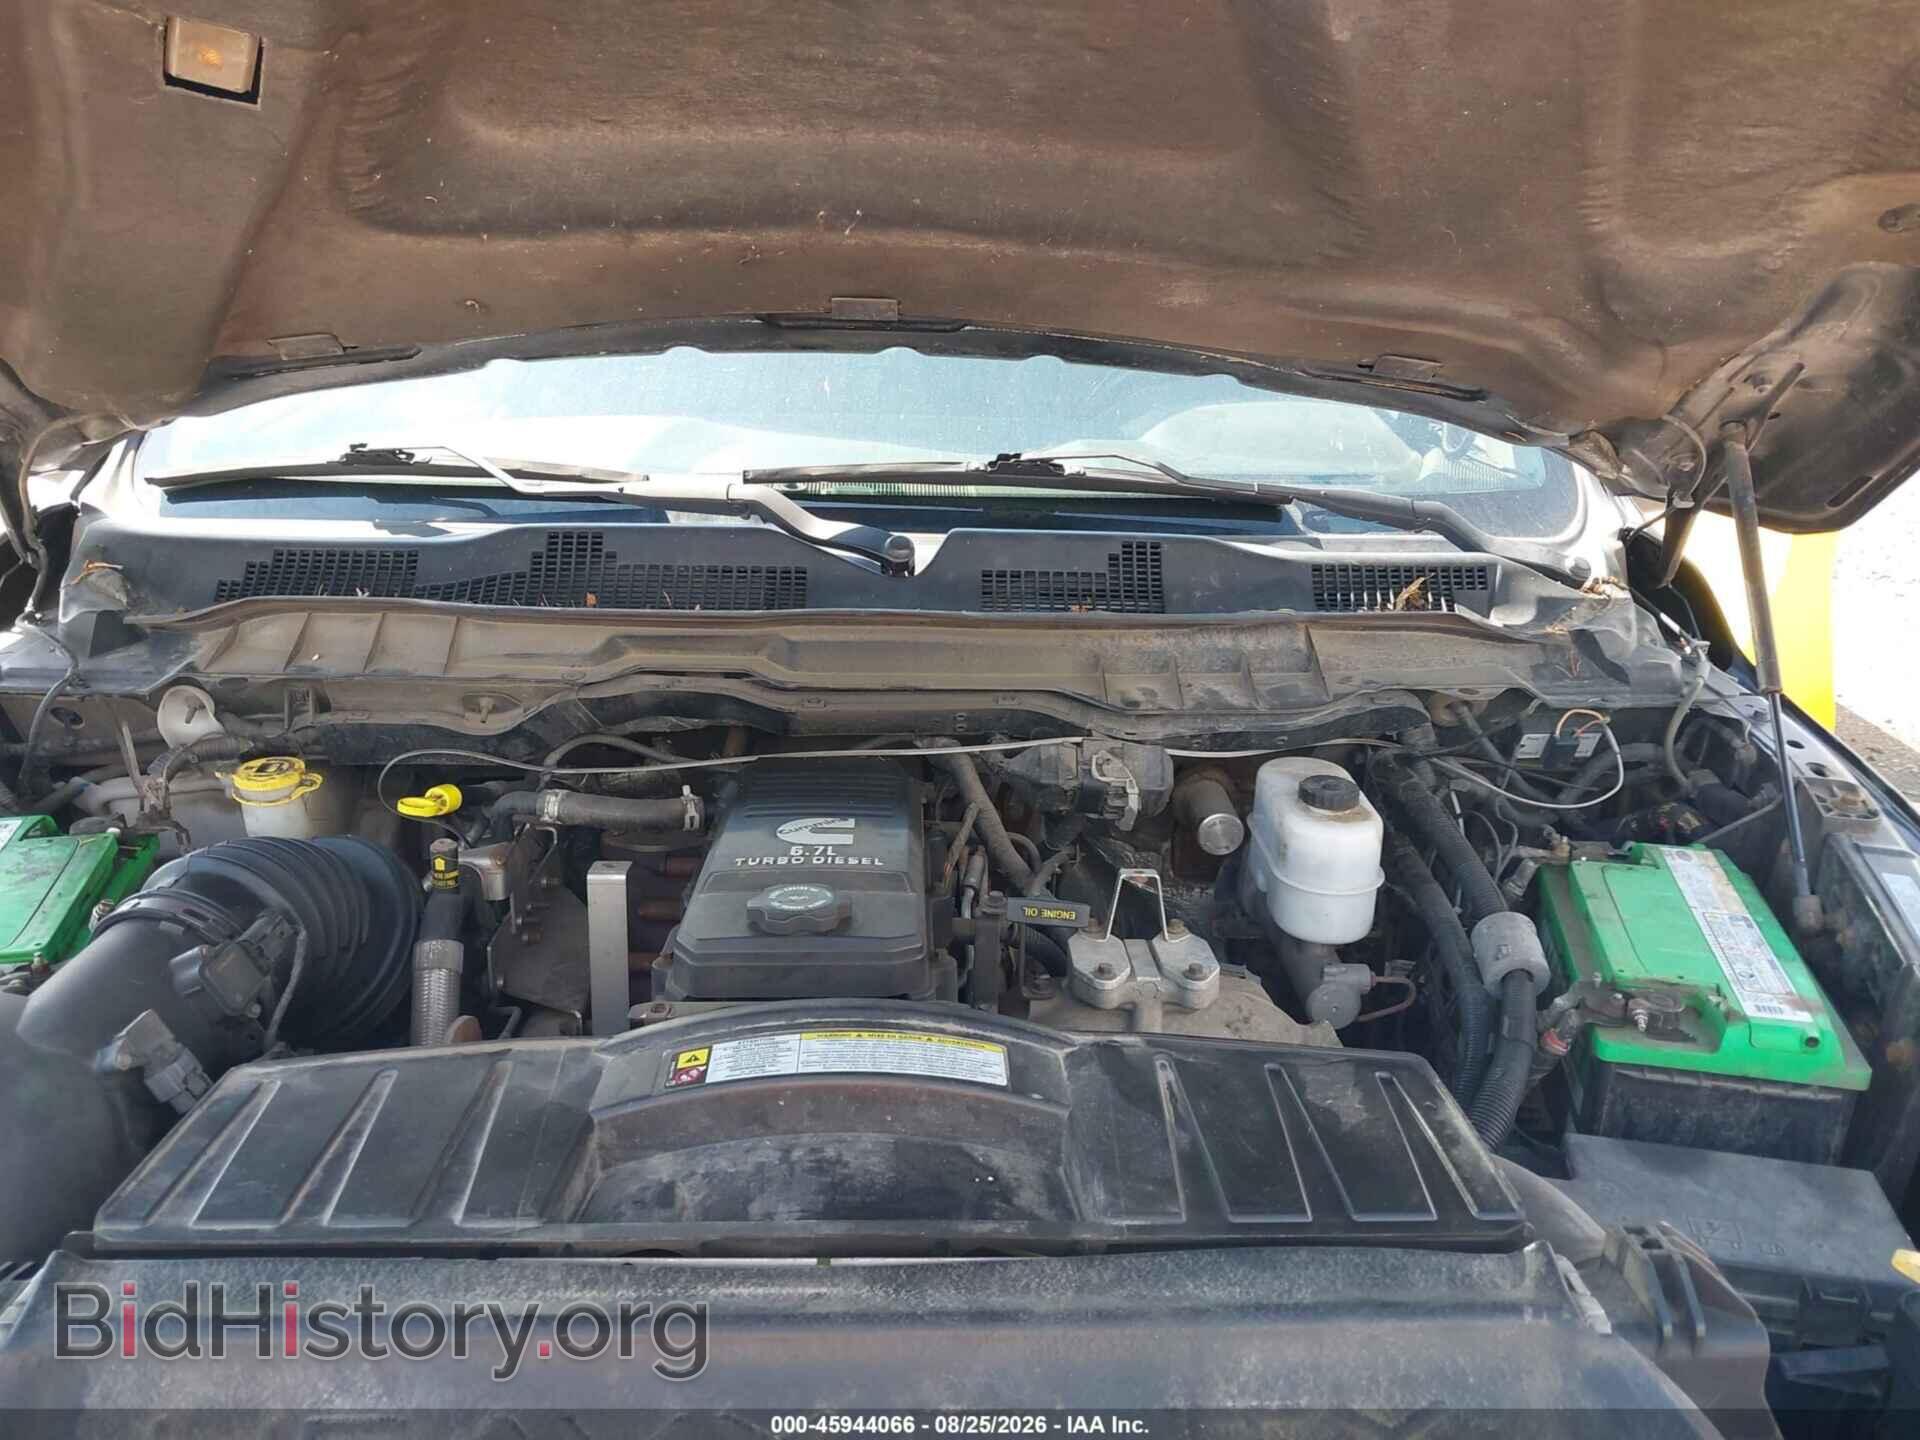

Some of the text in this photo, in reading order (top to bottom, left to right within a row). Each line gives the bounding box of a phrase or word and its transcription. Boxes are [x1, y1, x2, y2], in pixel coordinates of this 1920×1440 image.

[789, 846, 837, 856] 6.7L
[735, 856, 884, 866] TURBO DIESEL
[1023, 907, 1076, 920] ENGINE OIL
